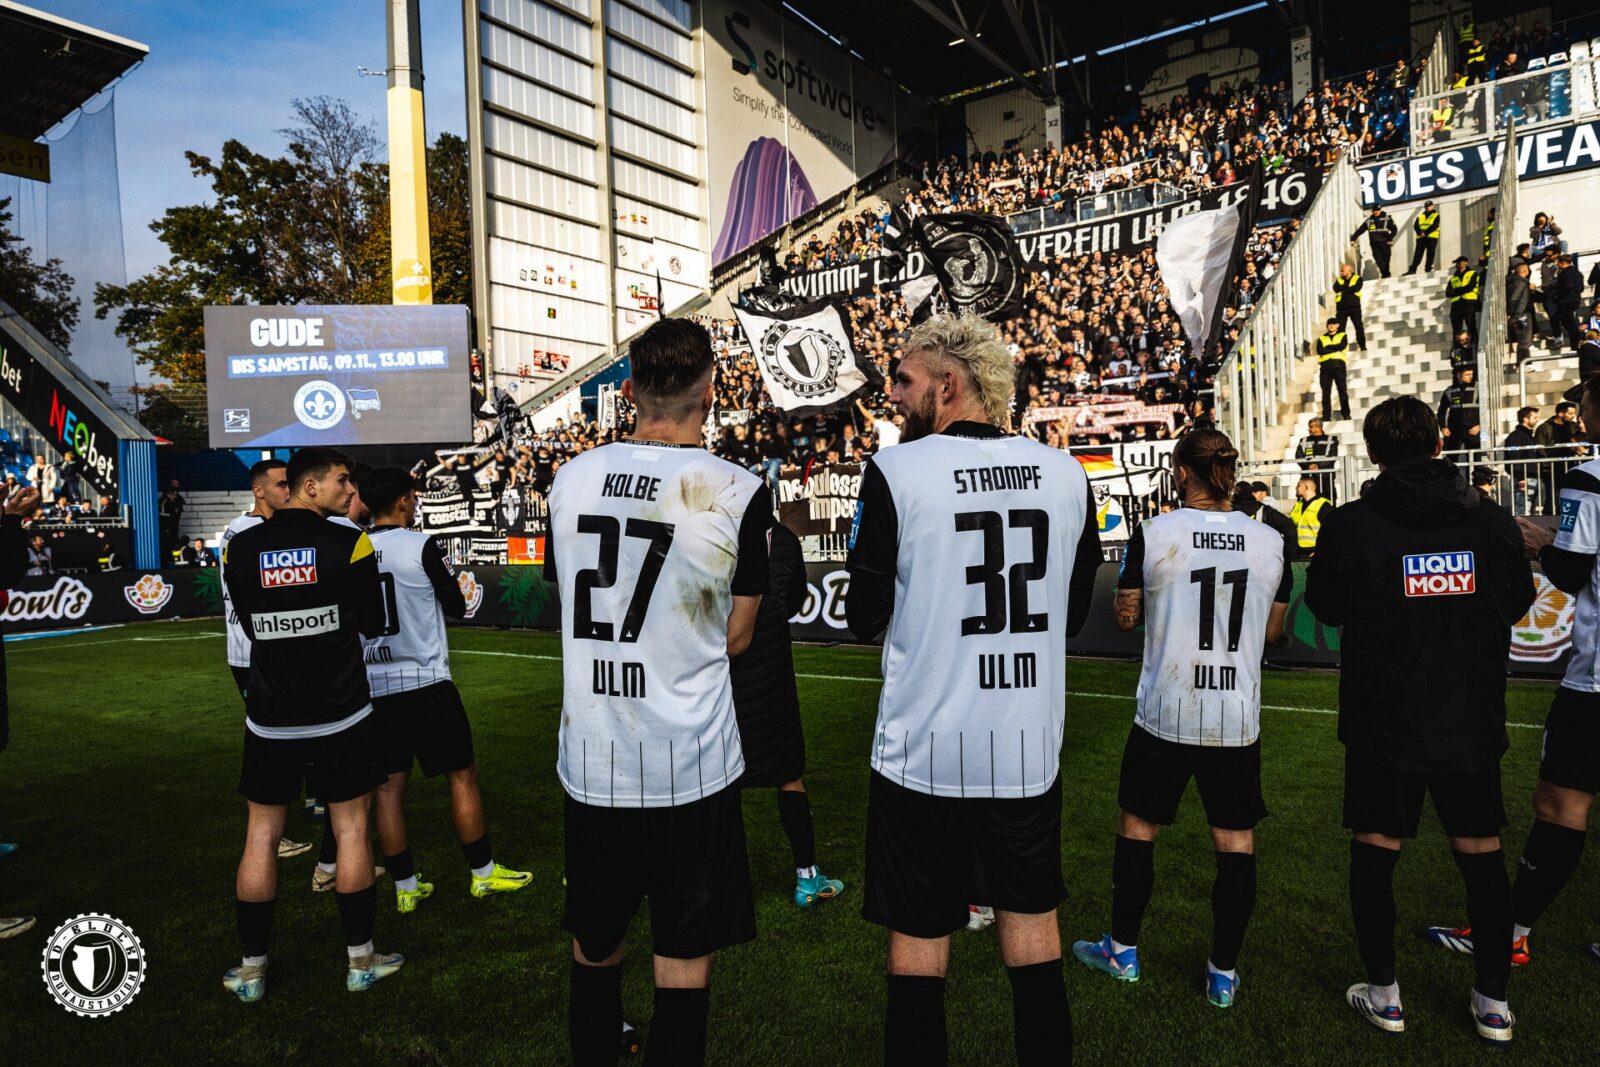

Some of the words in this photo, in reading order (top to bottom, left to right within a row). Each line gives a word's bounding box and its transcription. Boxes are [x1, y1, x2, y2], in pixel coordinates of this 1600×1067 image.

[764, 49, 875, 131] software
[733, 87, 769, 119] Simplify
[771, 105, 785, 123] the
[788, 114, 831, 145] Connected
[831, 136, 853, 156] World
[1015, 221, 1121, 263] VEREIN
[250, 318, 324, 347] GUDE
[0, 346, 22, 393] bet
[232, 359, 255, 375] BIS
[260, 356, 332, 373] SAMSTAG,
[379, 353, 416, 368] 13.00
[418, 350, 444, 366] UHR
[602, 473, 661, 502] KOLBE
[953, 466, 1042, 494] STROMPF
[1193, 532, 1245, 551] CHESSA
[262, 550, 312, 569] LIQUI
[954, 509, 1049, 637] 32
[1408, 554, 1470, 575] LIQUI
[264, 566, 318, 586] MOLY
[574, 514, 675, 643] 27
[1409, 574, 1472, 594] MOLY
[4, 581, 88, 616] owl's
[1190, 567, 1248, 652] 11
[254, 609, 336, 634] uhlsport
[592, 659, 645, 698] ULM
[979, 652, 1036, 689] ULM
[1195, 665, 1236, 691] ULM
